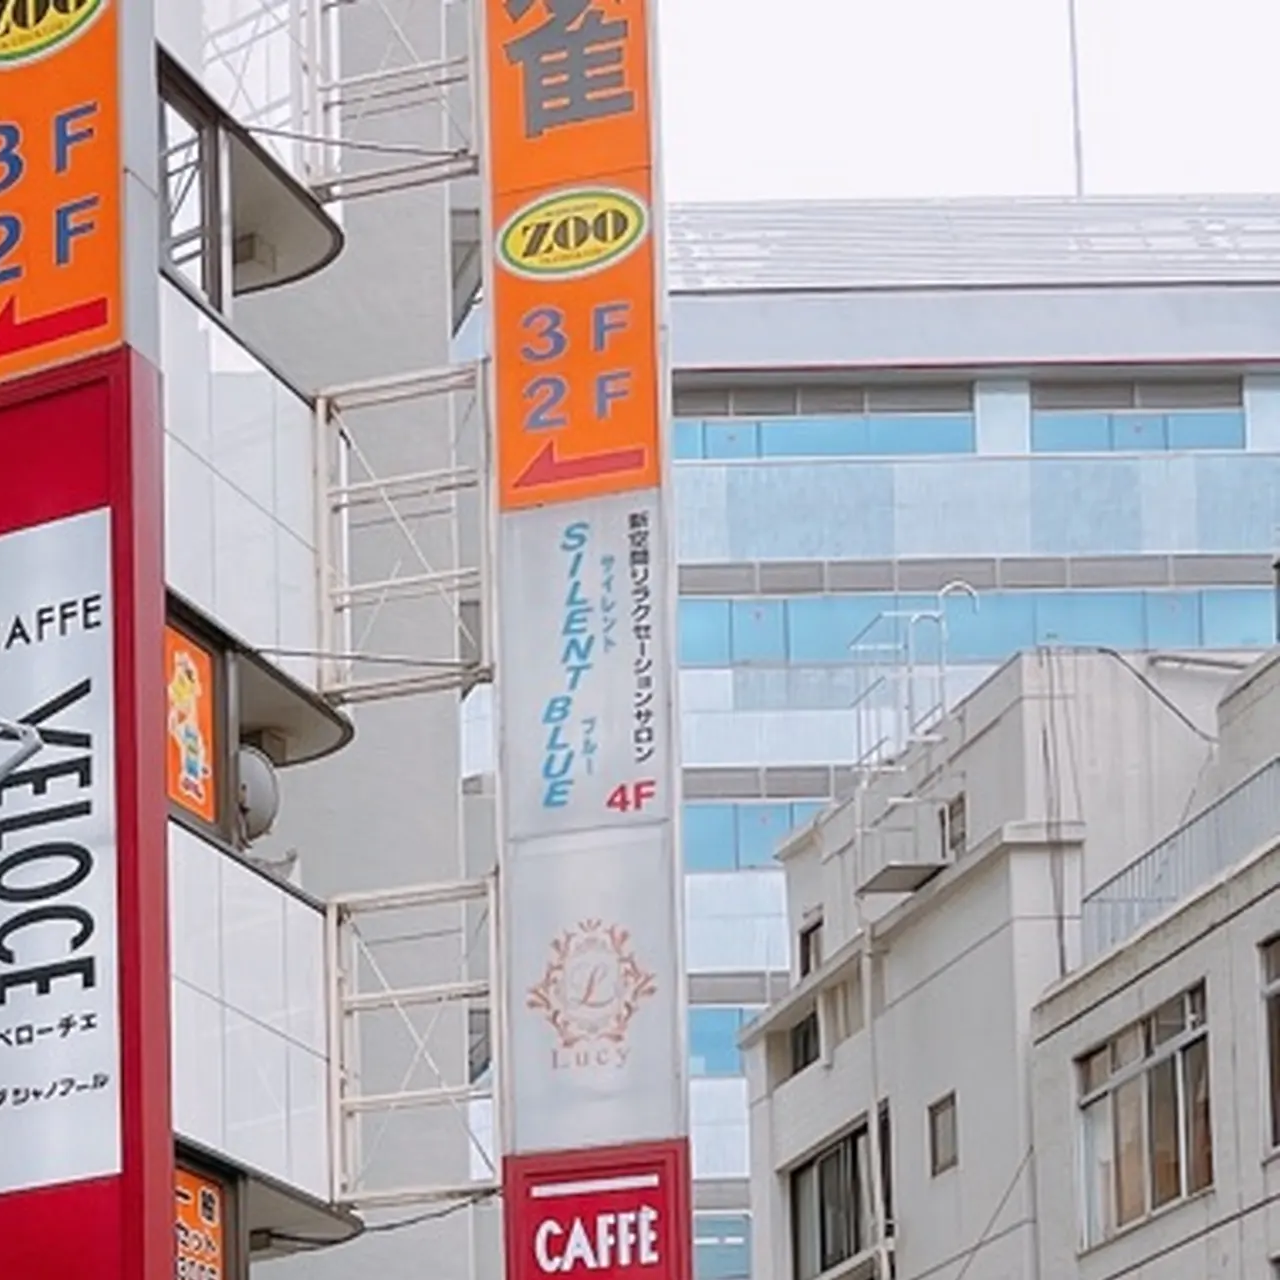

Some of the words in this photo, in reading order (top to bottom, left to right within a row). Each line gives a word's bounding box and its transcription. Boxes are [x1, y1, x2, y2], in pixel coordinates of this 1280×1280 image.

[521, 208, 629, 258] ZOO
[561, 521, 595, 691] SILENT
[600, 555, 617, 652] サイレント
[543, 697, 574, 809] BLUE
[581, 717, 597, 776] ブルー
[606, 780, 656, 812] 4F
[535, 1204, 659, 1273] CAFFÈ
